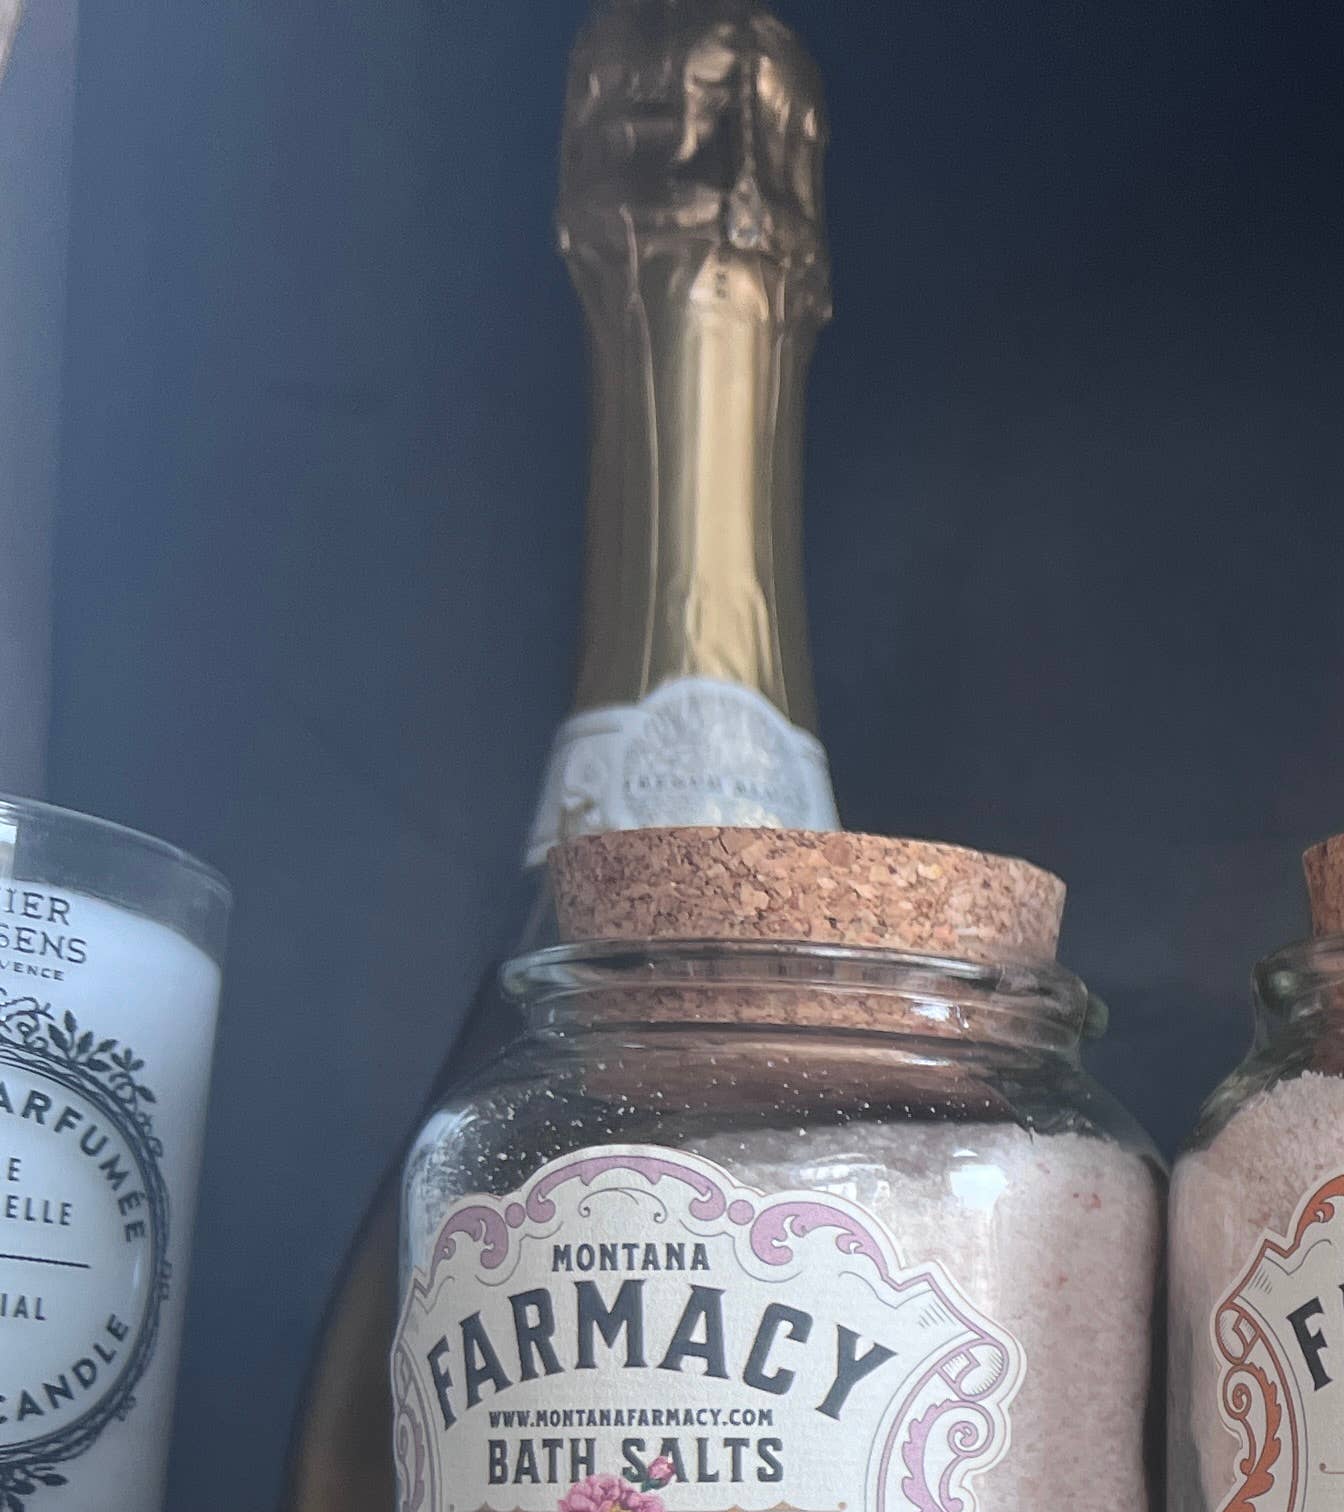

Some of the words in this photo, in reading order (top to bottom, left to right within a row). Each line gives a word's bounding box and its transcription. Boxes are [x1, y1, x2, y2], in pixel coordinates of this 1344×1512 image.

[0, 886, 71, 926] IER
[552, 1243, 710, 1272] MONTANA
[427, 1280, 898, 1430] FARMACY
[489, 1408, 773, 1429] WWW.MONTANAFARMACY.COM
[489, 1438, 595, 1485] BATH
[623, 1437, 783, 1484] SALTS
